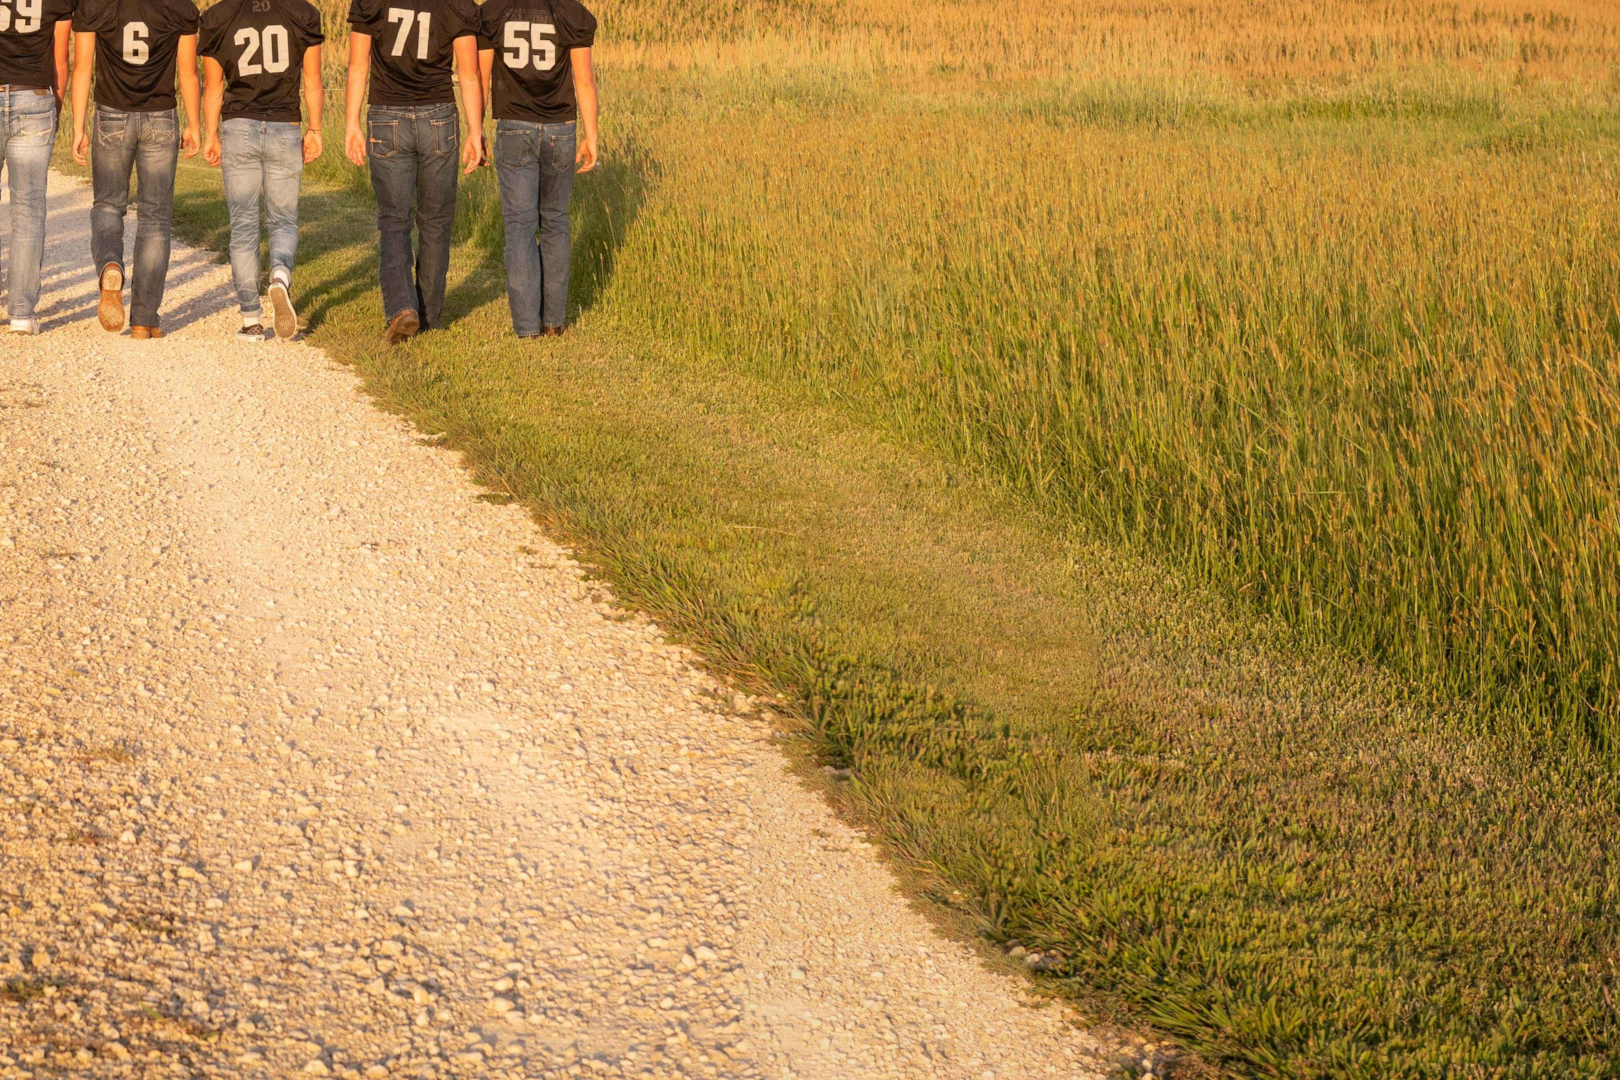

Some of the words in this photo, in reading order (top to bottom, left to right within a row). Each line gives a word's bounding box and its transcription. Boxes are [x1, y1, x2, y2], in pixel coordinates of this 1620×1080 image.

[122, 22, 150, 65] 6
[234, 24, 290, 77] 20
[387, 7, 433, 60] 71
[503, 21, 557, 71] 55
